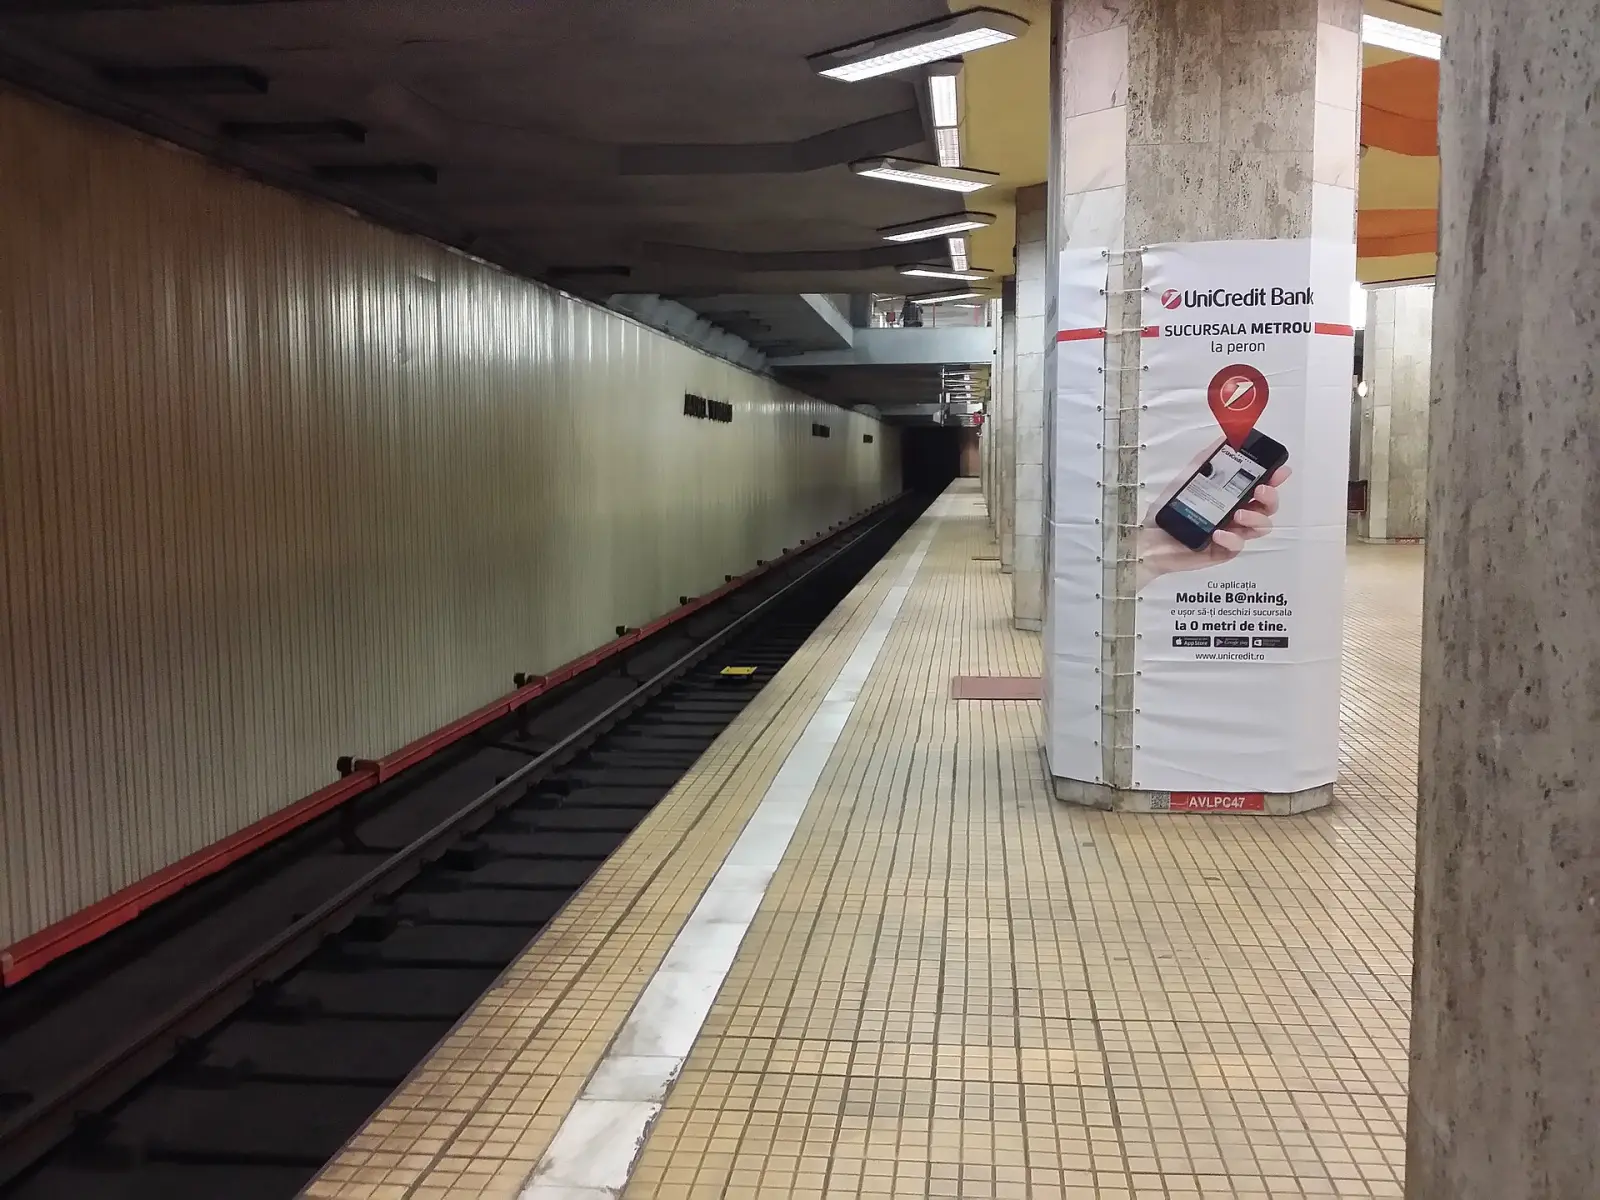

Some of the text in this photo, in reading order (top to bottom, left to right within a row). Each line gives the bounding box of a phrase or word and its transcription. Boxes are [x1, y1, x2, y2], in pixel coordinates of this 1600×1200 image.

[1184, 286, 1314, 308] UniCredit Bank
[1164, 321, 1312, 337] SUCURSALA METROU
[1211, 340, 1266, 355] la peron
[1207, 581, 1218, 589] Cu
[1176, 592, 1288, 606] Mobile B@nking,
[1217, 607, 1251, 616] deschizi
[1253, 607, 1293, 617] sucursala
[1175, 620, 1287, 631] la 0 metri de tine.
[1195, 652, 1265, 661] www.unicredit.ro
[1189, 797, 1245, 808] AVLPC47
